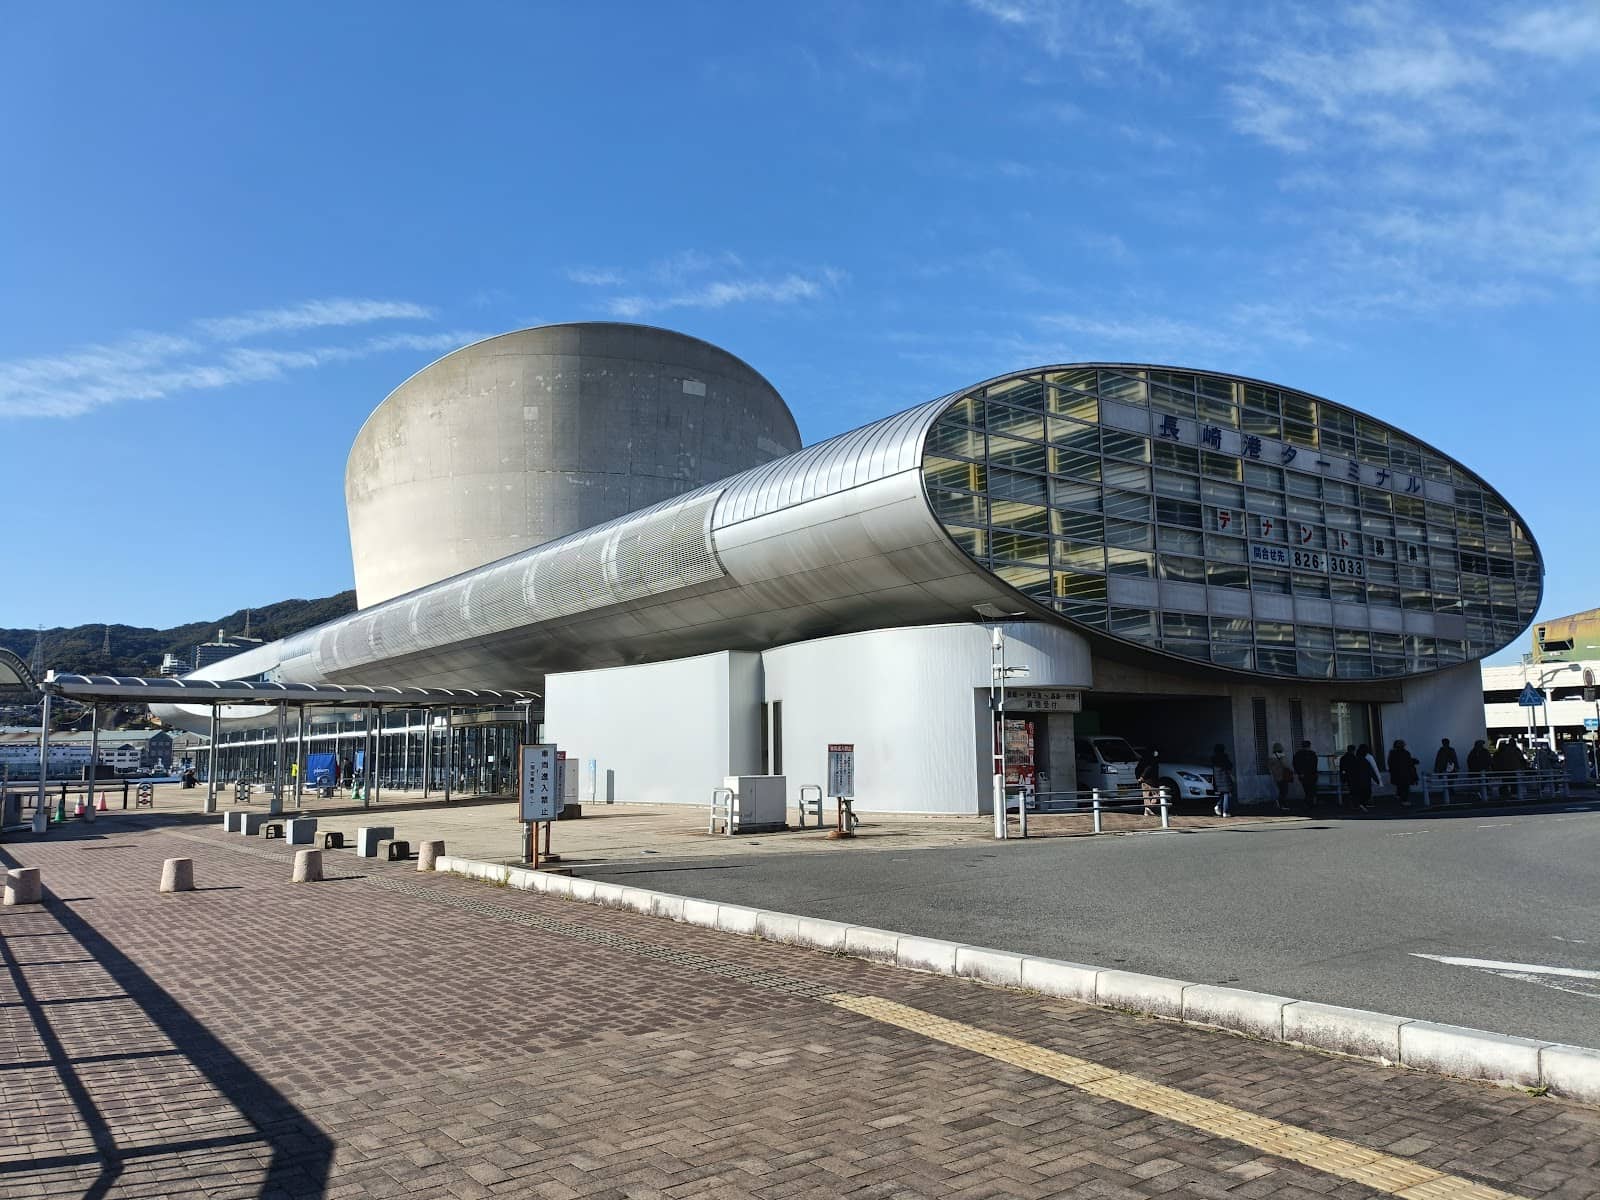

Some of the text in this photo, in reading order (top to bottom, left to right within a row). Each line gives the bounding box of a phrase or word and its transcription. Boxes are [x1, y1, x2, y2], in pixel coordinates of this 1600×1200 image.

[1159, 414, 1421, 493] 長崎港ターミナル
